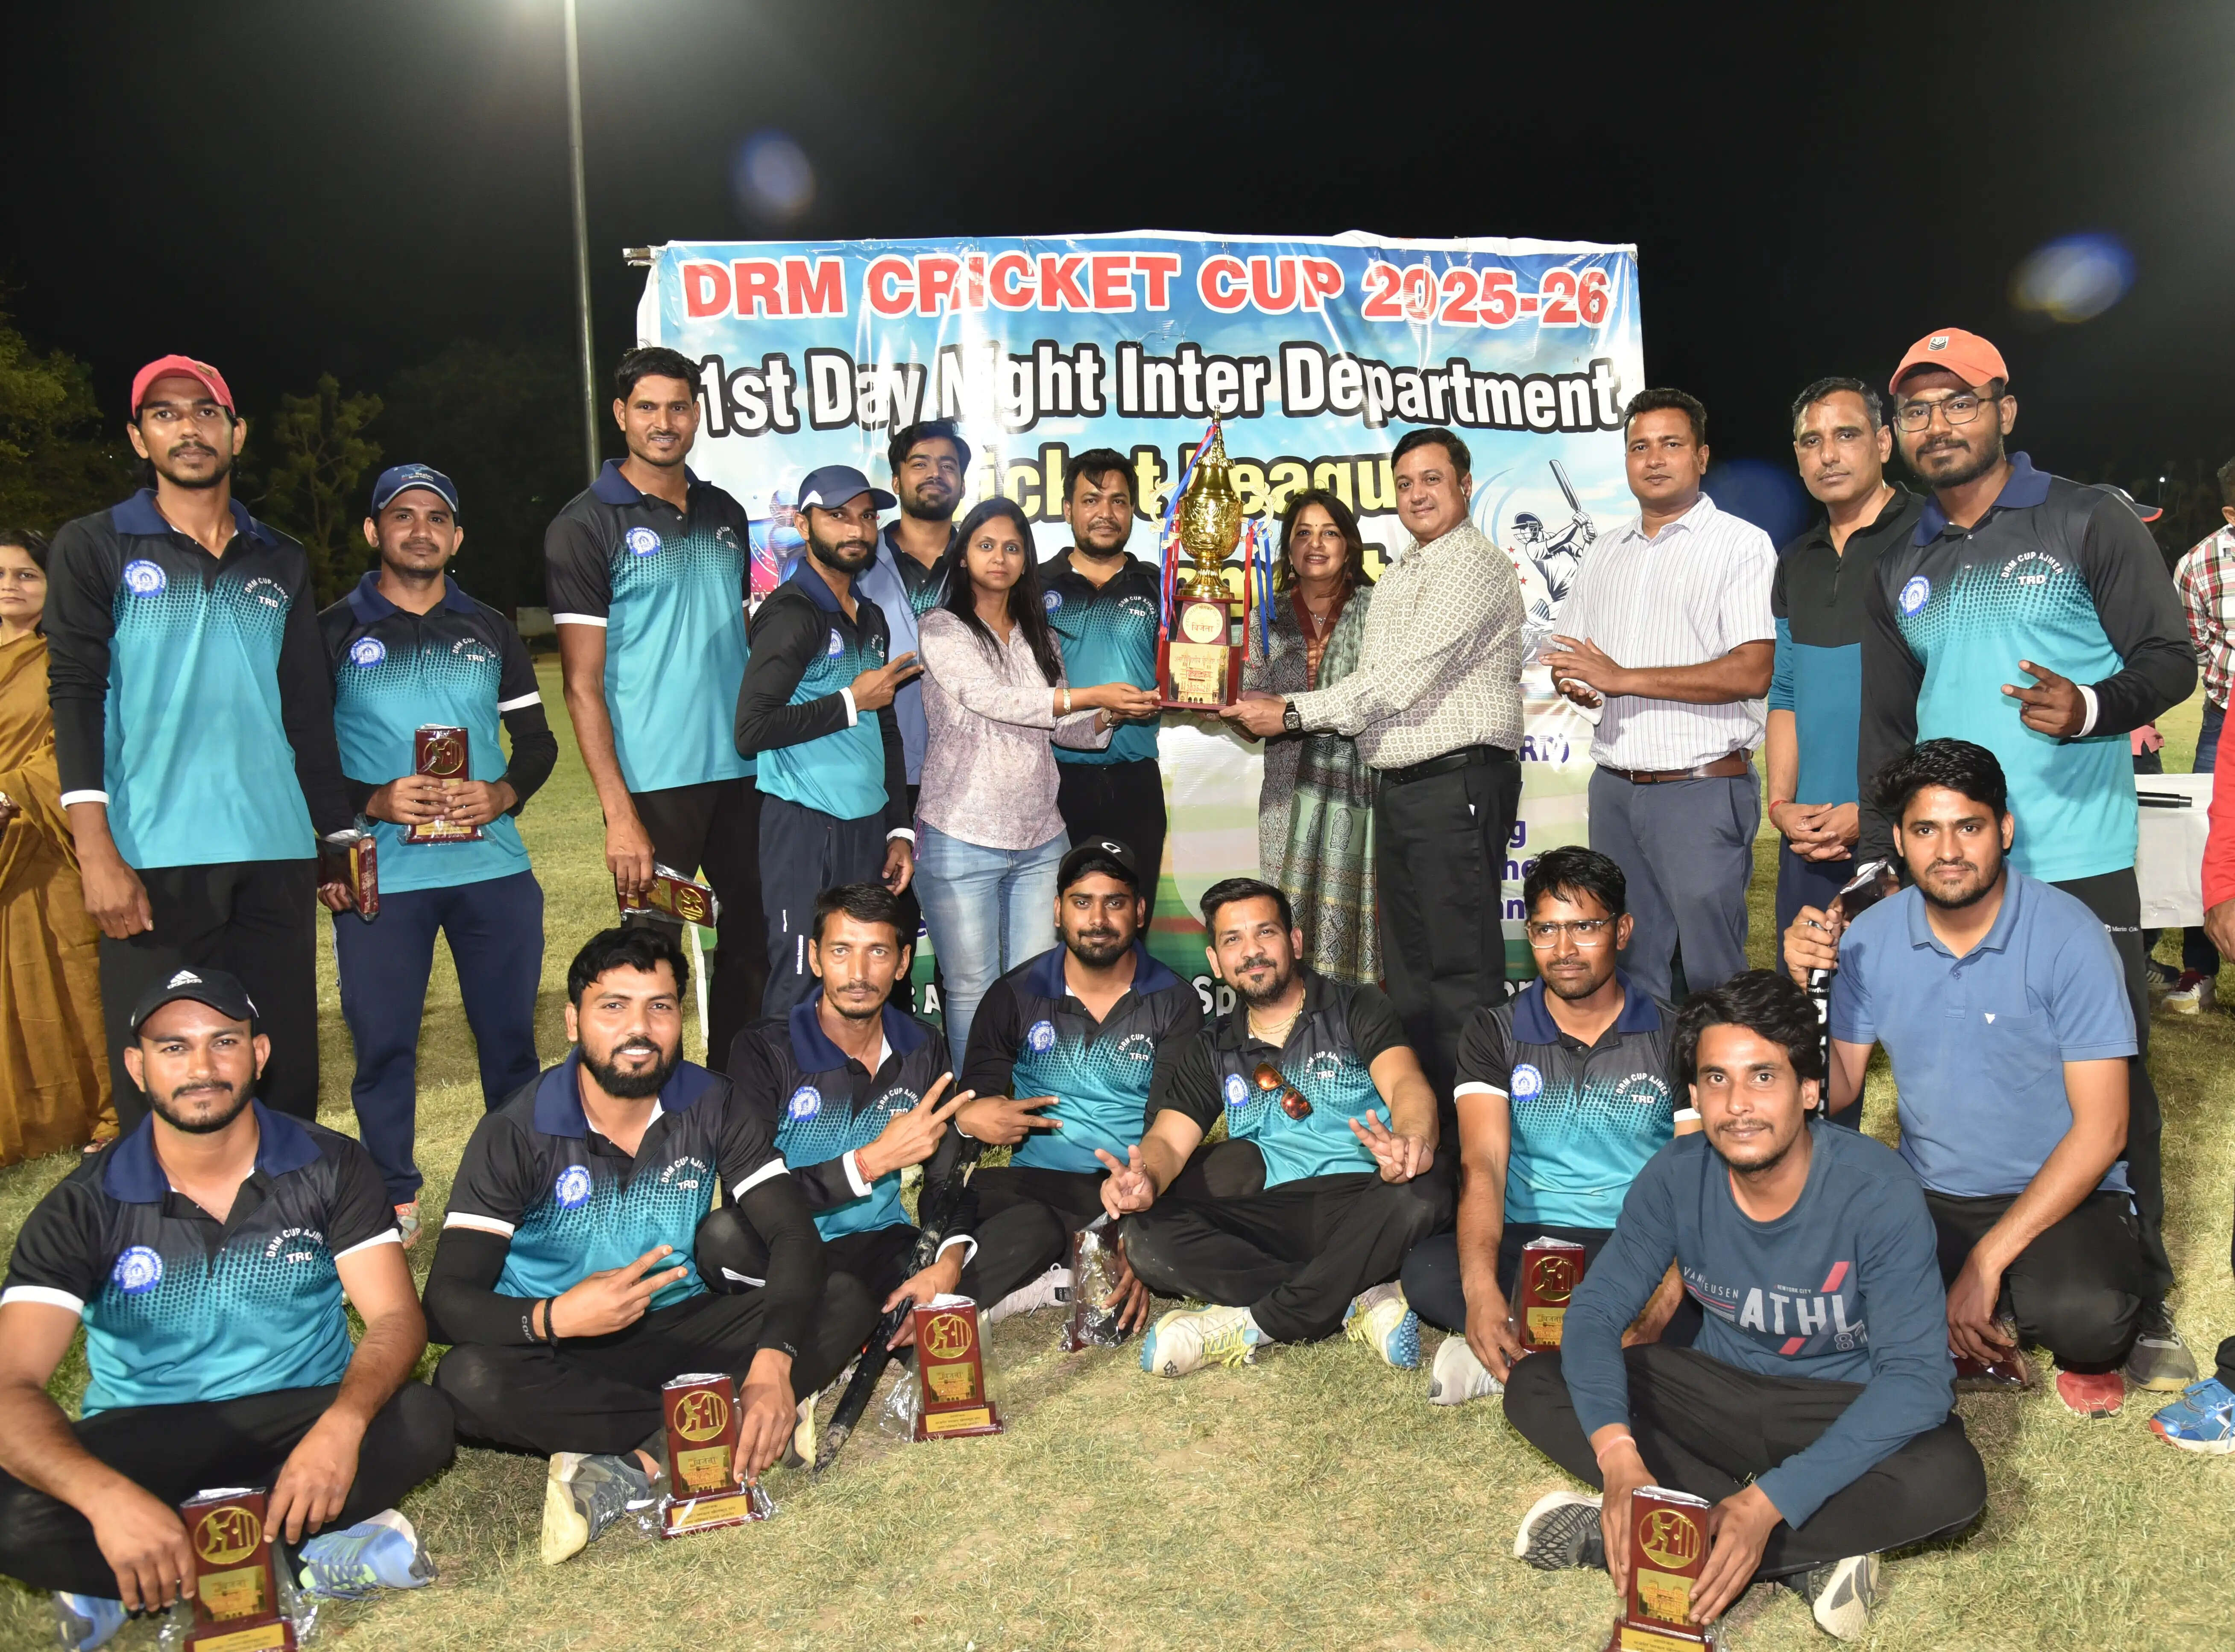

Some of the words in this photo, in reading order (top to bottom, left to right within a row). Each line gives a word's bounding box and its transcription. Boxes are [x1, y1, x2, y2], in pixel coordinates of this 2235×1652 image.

[684, 256, 845, 318] DRM
[867, 253, 1179, 315] CRICKET
[1199, 255, 1344, 311] CUP
[1363, 264, 1609, 327] 2025-26
[698, 355, 798, 434] 1st
[810, 349, 923, 436] Day
[1120, 344, 1267, 416] Inter
[1281, 344, 1621, 427] Department
[2001, 560, 2017, 578] DRM
[2017, 551, 2036, 562] CUP
[2038, 552, 2063, 574] AJMER
[244, 579, 258, 594] DRM
[2018, 575, 2046, 585] TRD
[258, 595, 278, 608] TRD
[1118, 598, 1129, 607] DRM
[1129, 608, 1145, 617] TRD
[1192, 622, 1213, 632] विजेता
[453, 641, 463, 654] DRM
[1118, 1038, 1131, 1051] DRM
[1130, 1053, 1148, 1061] TRD
[1316, 1070, 1335, 1079] TRD
[1616, 1078, 1631, 1094] DRM
[1631, 1073, 1647, 1081] CUP
[1649, 1075, 1668, 1096] AJMER
[878, 1094, 889, 1110] DRM
[889, 1088, 902, 1097] CUP
[1631, 1094, 1654, 1104] TRD
[661, 1165, 675, 1183] DRM
[674, 1156, 688, 1167] CUP
[677, 1180, 698, 1190] TRD
[266, 1236, 284, 1257] DRM
[282, 1228, 301, 1238] CUP
[286, 1251, 313, 1263] TRD
[1684, 1266, 1702, 1283] VAN
[1739, 1287, 1863, 1336] ATHL
